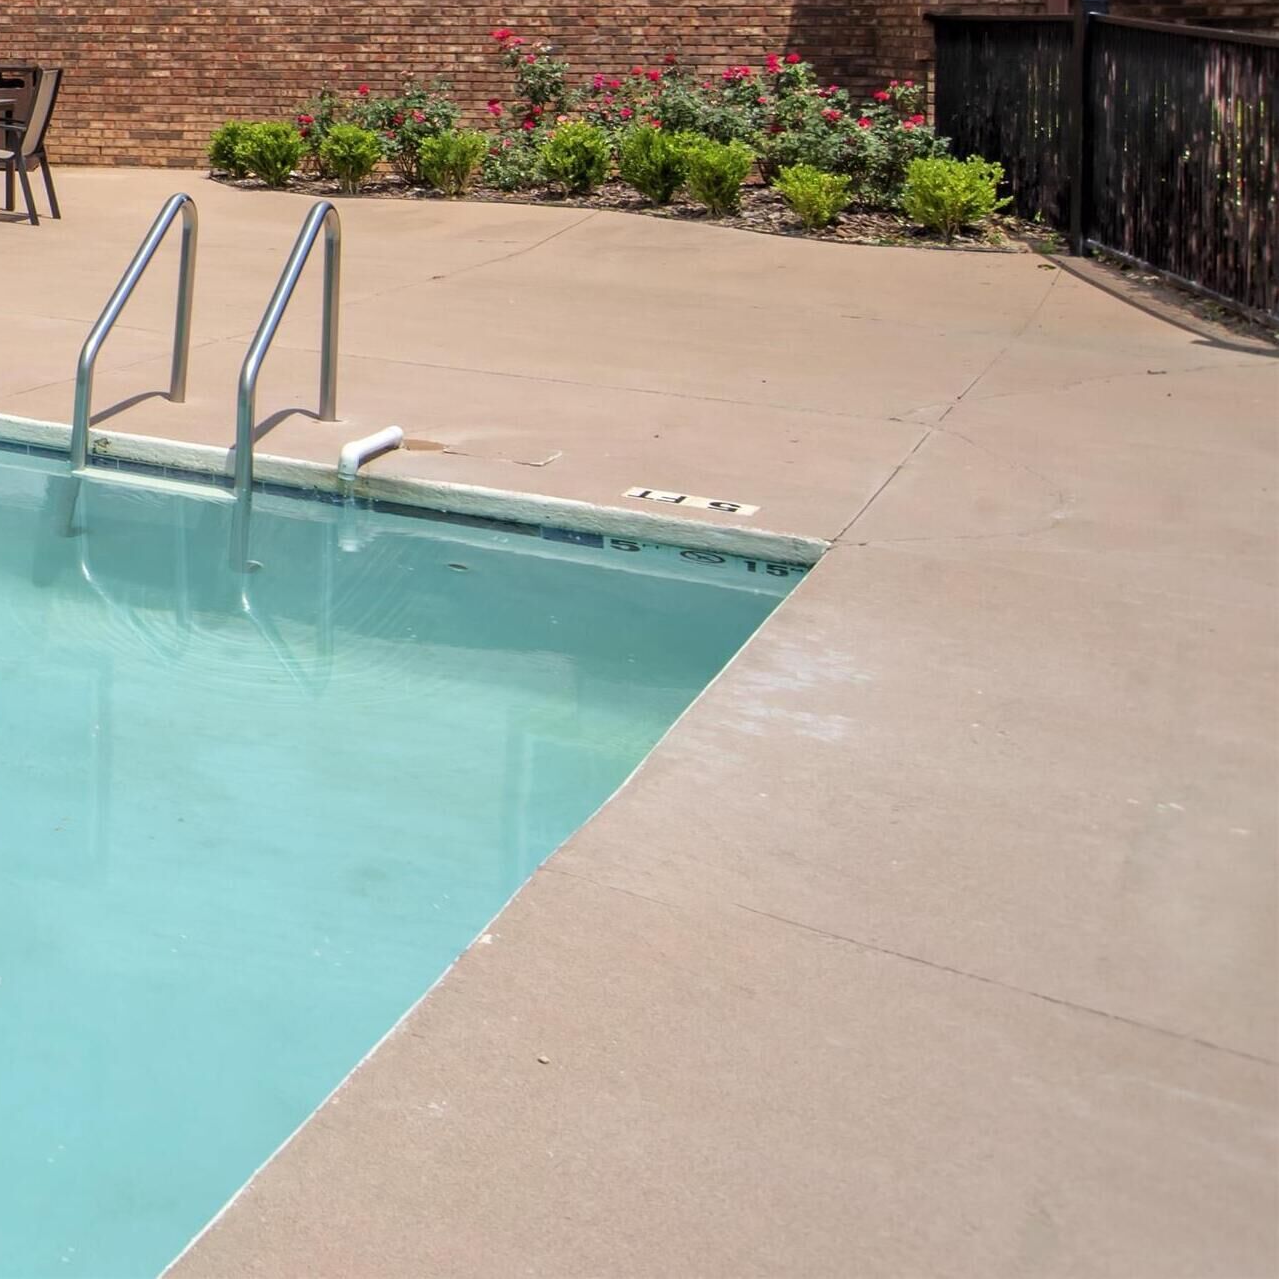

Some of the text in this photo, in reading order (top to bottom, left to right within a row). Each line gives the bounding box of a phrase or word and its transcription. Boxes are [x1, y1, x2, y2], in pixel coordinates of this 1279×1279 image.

[627, 490, 741, 513] 5 FT
[610, 539, 640, 552] 5
